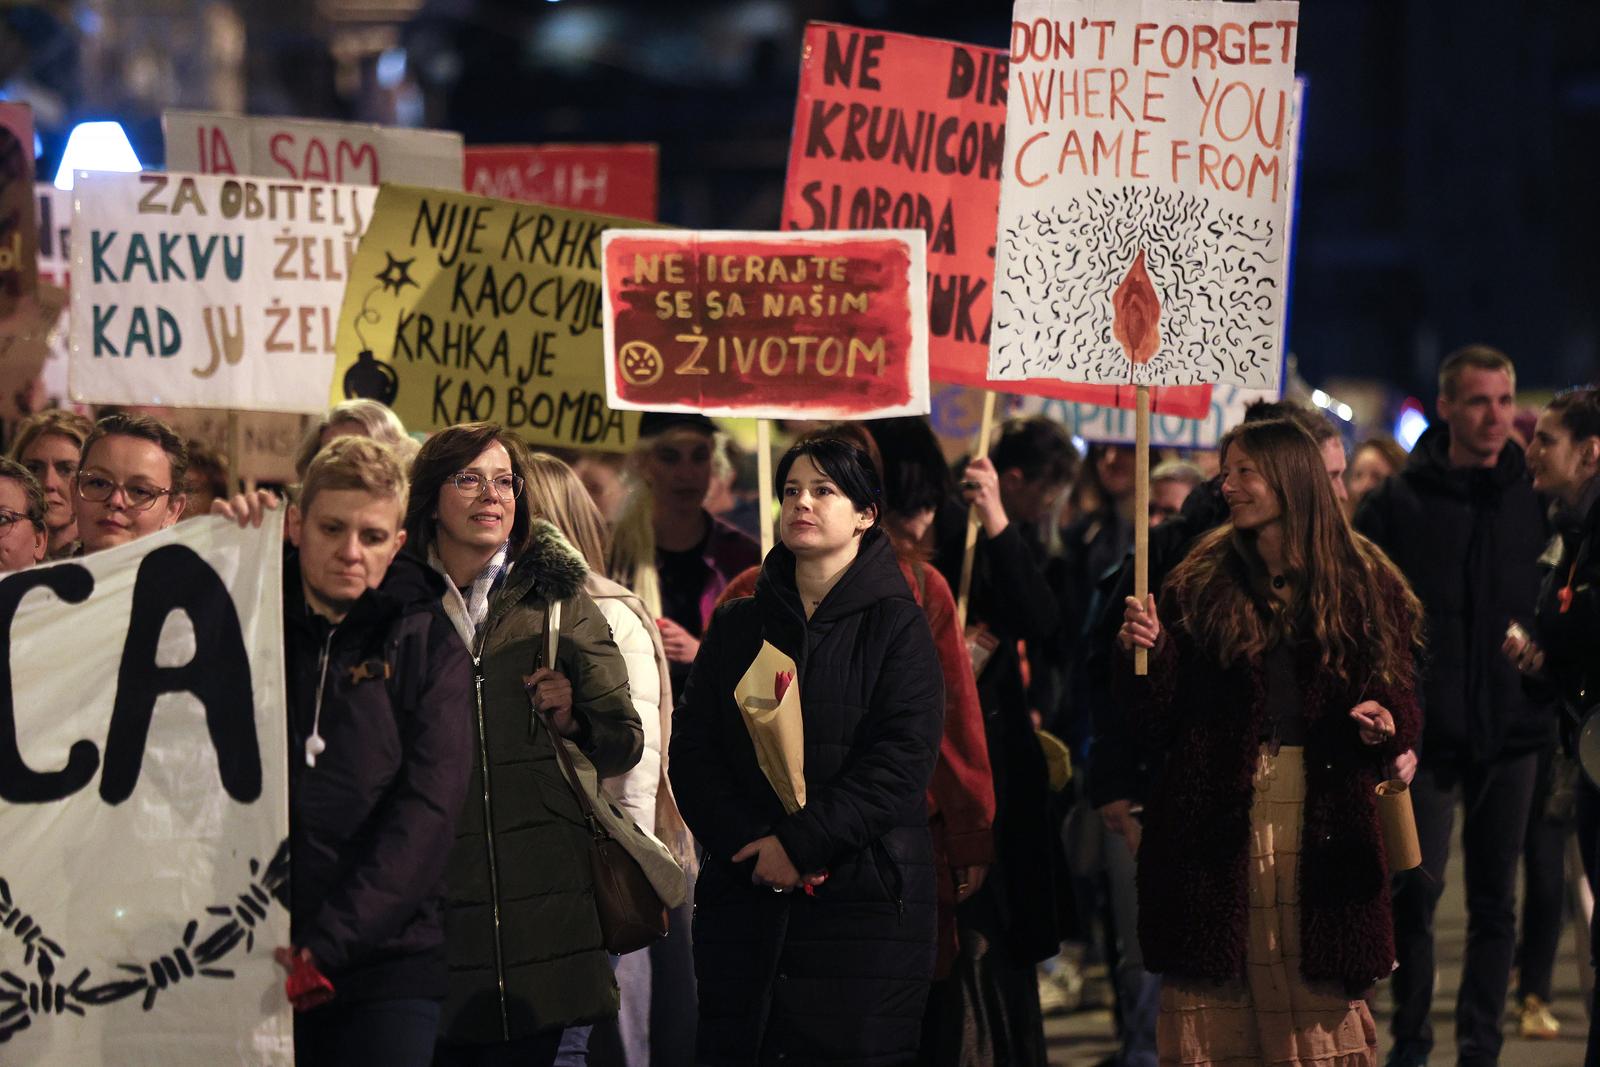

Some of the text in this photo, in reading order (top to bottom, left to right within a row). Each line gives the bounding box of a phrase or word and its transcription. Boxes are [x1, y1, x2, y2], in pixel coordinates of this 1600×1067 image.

[823, 30, 886, 91] NE
[1010, 17, 1298, 70] DON'T FORGET
[804, 99, 1004, 180] KRUNICOM
[1018, 67, 1285, 150] WHERE YOU
[269, 133, 380, 185] SAM
[1014, 128, 1279, 203] CAME FROM
[138, 175, 363, 237] ZA OBITELJ
[411, 199, 492, 268] NIJE
[91, 230, 245, 283] KAKVU
[634, 254, 848, 284] NE IGRAJTE
[655, 284, 869, 320] SE SA NAŠIM
[92, 305, 181, 357] KAD
[192, 305, 245, 379] JU
[392, 308, 556, 385] KRHKA JE
[674, 325, 886, 378] ŽIVOTOM
[433, 375, 625, 444] KAO BOMBA
[0, 543, 263, 806] CA
